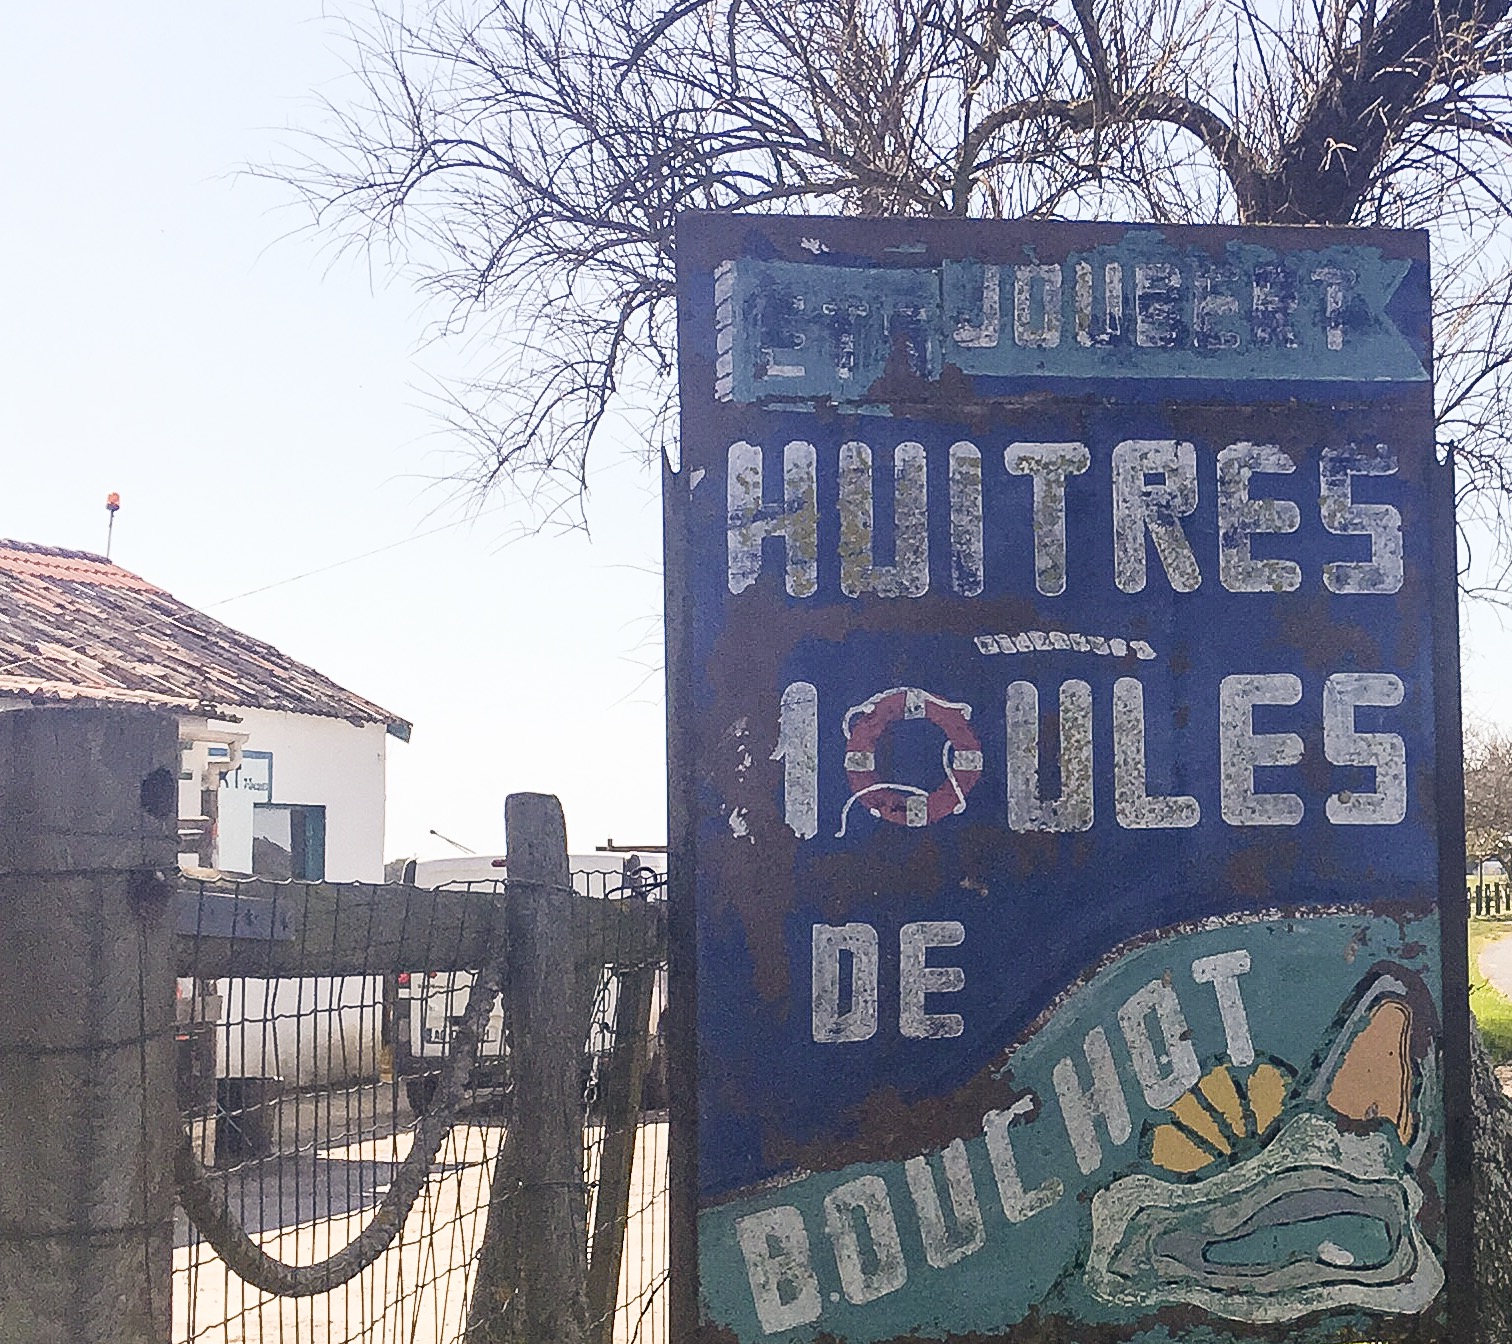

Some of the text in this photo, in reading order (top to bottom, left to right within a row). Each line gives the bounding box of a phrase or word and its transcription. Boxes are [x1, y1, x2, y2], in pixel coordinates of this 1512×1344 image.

[726, 440, 1404, 598] HUITRES
[811, 920, 966, 1044] DE
[735, 949, 1254, 1335] BOUCHOT
